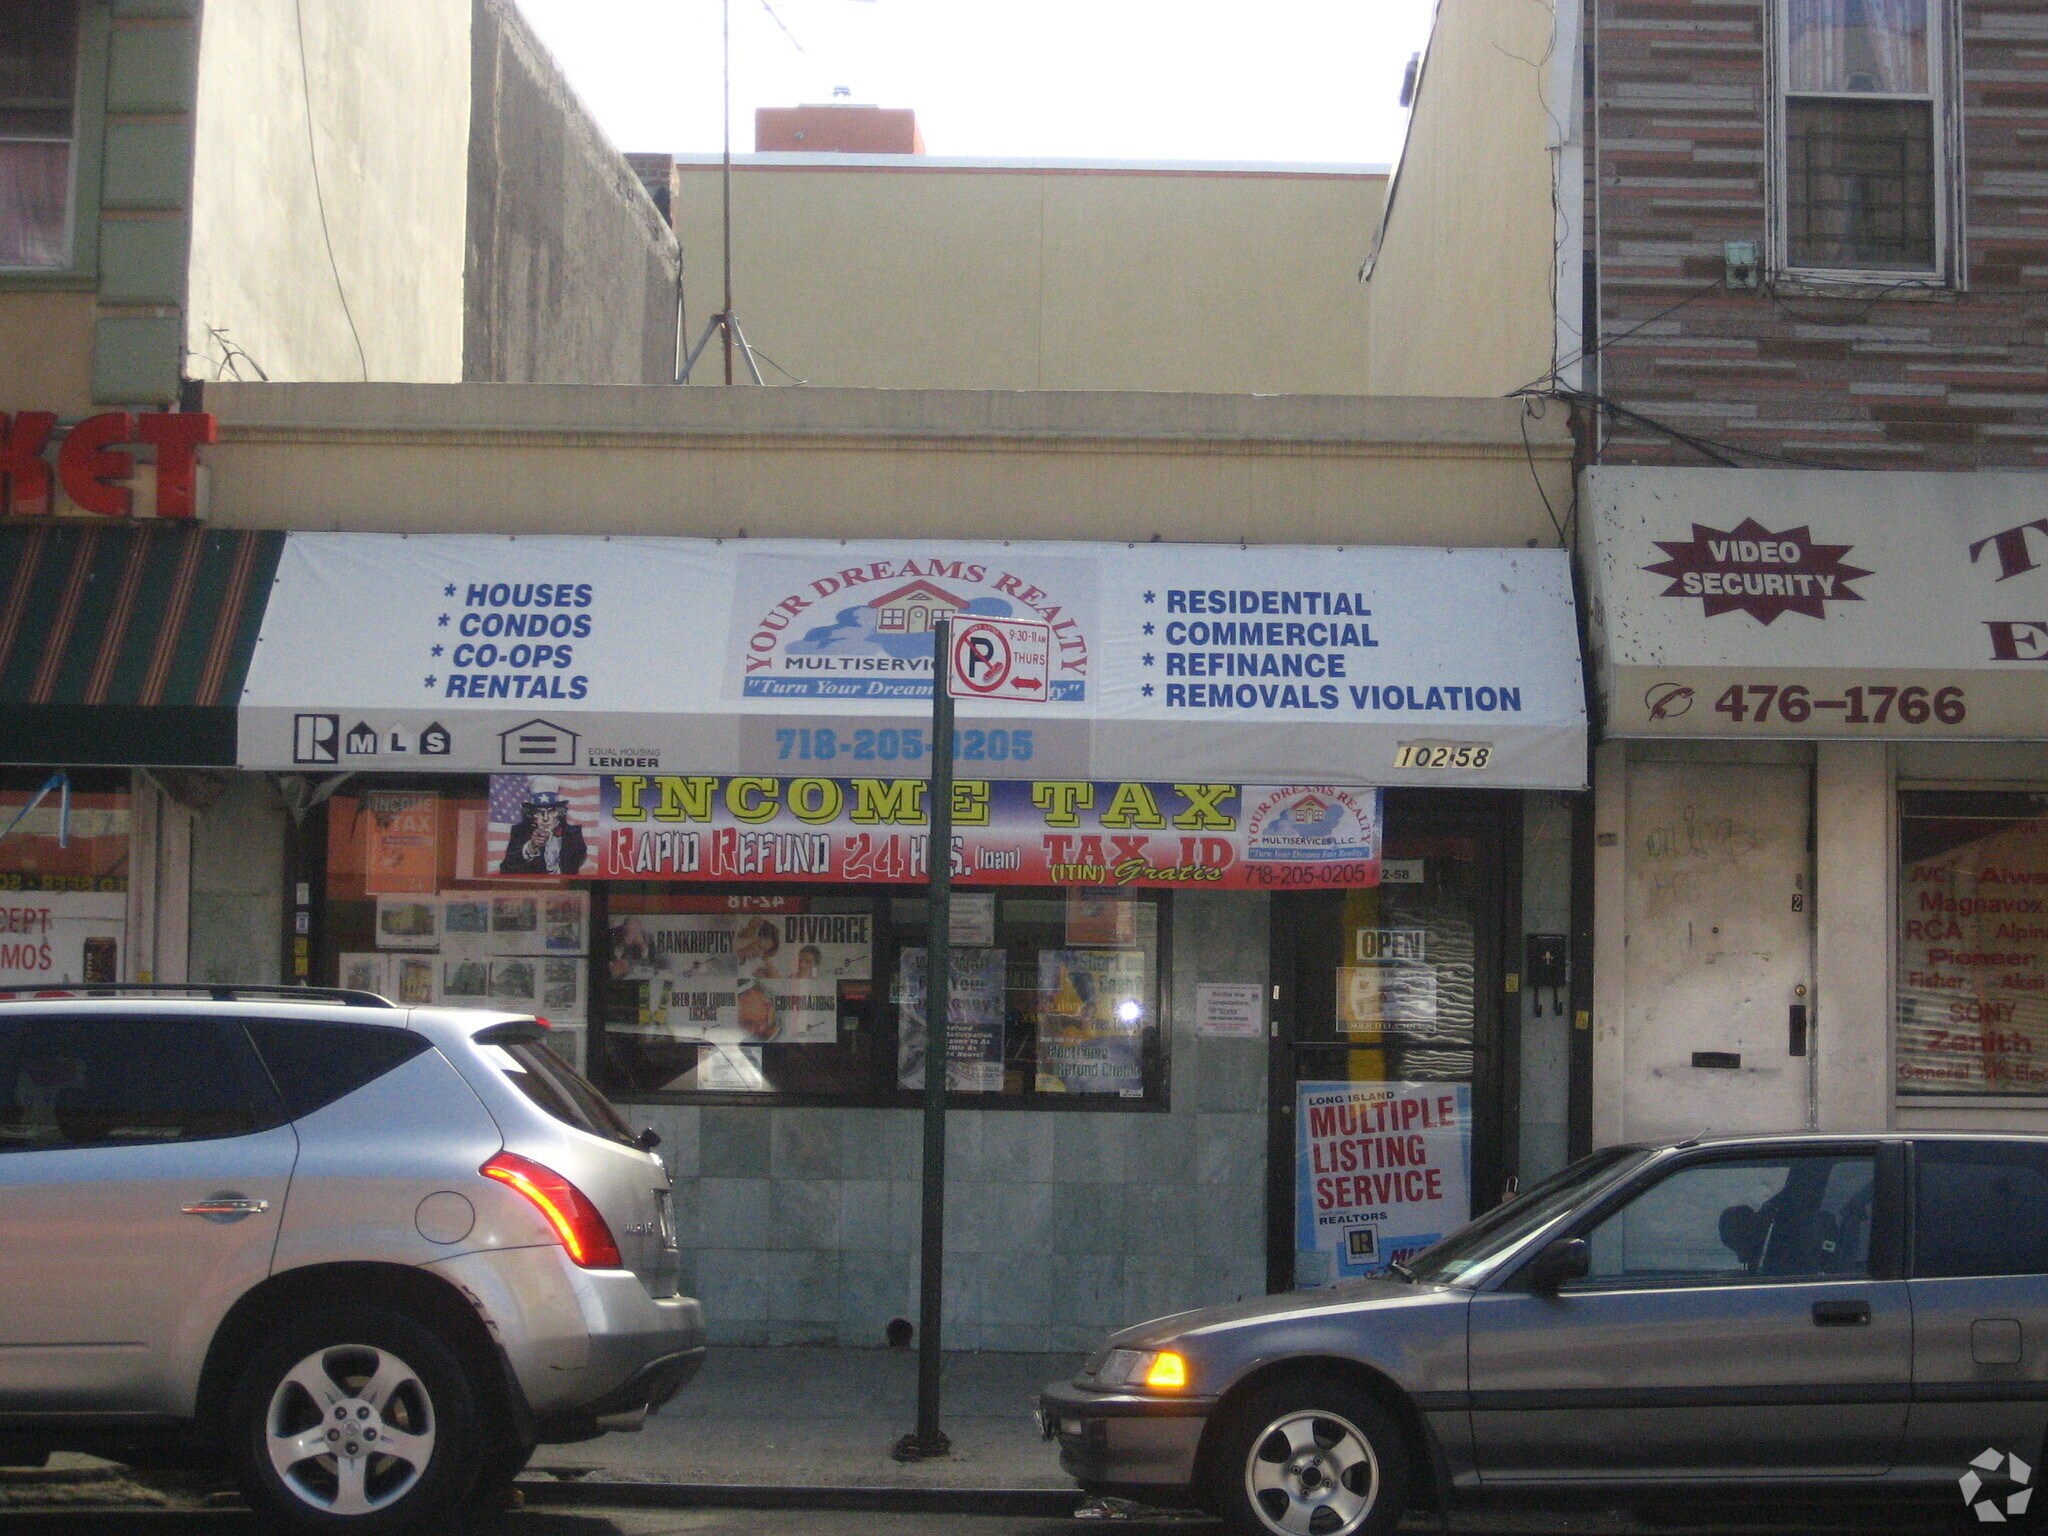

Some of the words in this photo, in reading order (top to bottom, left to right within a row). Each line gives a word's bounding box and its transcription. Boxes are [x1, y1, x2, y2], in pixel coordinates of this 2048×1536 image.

[1708, 540, 1801, 563] VIDEO
[465, 583, 593, 608] HOUSES
[1682, 572, 1836, 597] SECURITY
[1166, 590, 1372, 616] RESIDENTIAL
[458, 613, 593, 638] CONDOS
[744, 594, 814, 674] YOUR
[810, 558, 987, 598] DREAMS
[991, 571, 1088, 676] REALTY
[1166, 621, 1379, 648] COMMERCIAL
[451, 643, 573, 668] CO-OPS
[1013, 651, 1046, 666] THURS
[1166, 653, 1346, 678] REFINANCE
[445, 674, 588, 700] RENTALS
[815, 680, 862, 696] Your
[865, 681, 935, 697] Dream
[1165, 683, 1340, 710] REMOVALS
[1349, 685, 1522, 712] VIOLATION
[1714, 685, 1967, 725] 476-1766
[588, 747, 617, 756] EQUAL
[620, 748, 661, 757] HOUSING
[589, 757, 659, 768] LENDER
[611, 776, 991, 826] INCOME
[1032, 781, 1237, 831] TAX
[1248, 802, 1272, 846] YOUR
[1270, 784, 1336, 805] DREAMS
[1336, 791, 1372, 844] REALTY
[1042, 833, 1152, 870] TAX
[1178, 836, 1235, 870] ID
[1262, 836, 1332, 846] MULTISERVICES
[842, 832, 905, 880] 24
[909, 833, 972, 878] HS.
[1050, 863, 1107, 884] (ITIN)
[1113, 858, 1224, 886] Gratis
[1244, 863, 1366, 885] 718-205-0205
[657, 929, 736, 954] BANKRUPTCY
[785, 915, 869, 944] DIVORCE
[1906, 919, 1962, 942] RCA
[1361, 931, 1421, 959] OPEN
[1928, 948, 2038, 966] Pioneer
[774, 995, 836, 1011] CORPORATIONS
[1949, 1002, 2017, 1023] SONY
[1926, 1028, 2033, 1053] Zenith
[1308, 1094, 1343, 1106] LONG
[1348, 1091, 1395, 1102] ISLAND
[1308, 1096, 1456, 1139] MULTIPLE
[1312, 1133, 1427, 1175] LISTING
[1316, 1168, 1443, 1210] SERVICE
[1318, 1211, 1388, 1226] REALTORS
